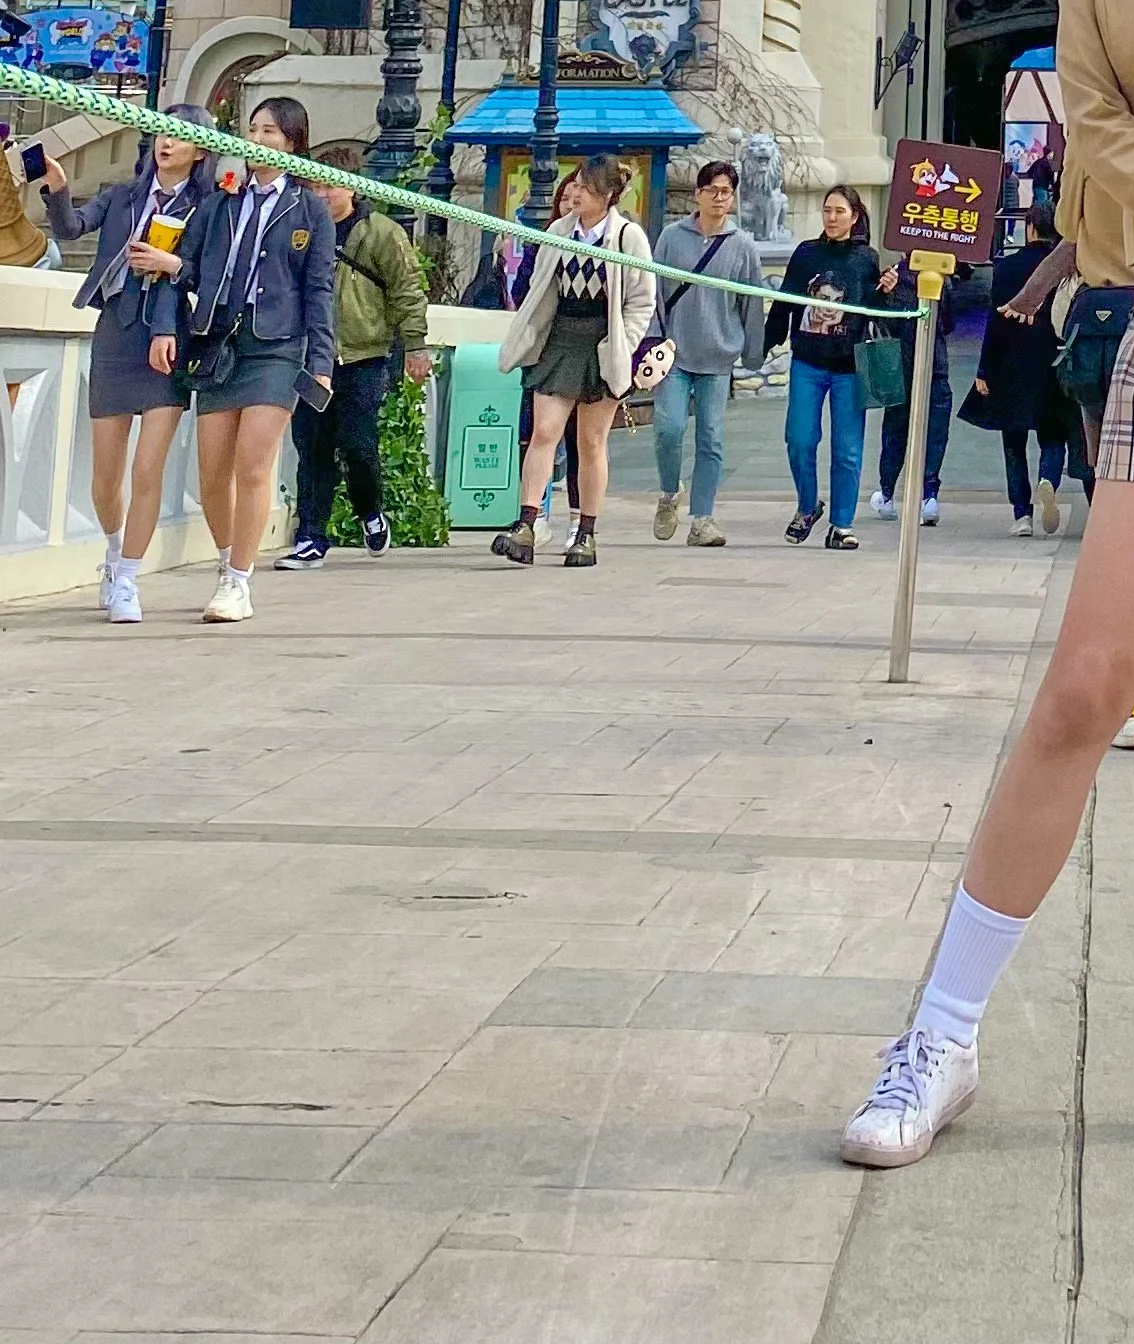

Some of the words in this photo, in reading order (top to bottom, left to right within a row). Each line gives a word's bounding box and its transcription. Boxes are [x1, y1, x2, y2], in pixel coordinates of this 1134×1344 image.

[902, 202, 979, 233] 우측통행
[900, 225, 921, 237] KEEP
[921, 228, 933, 238] TO
[933, 230, 949, 241] THE
[950, 232, 978, 245] RIGHT
